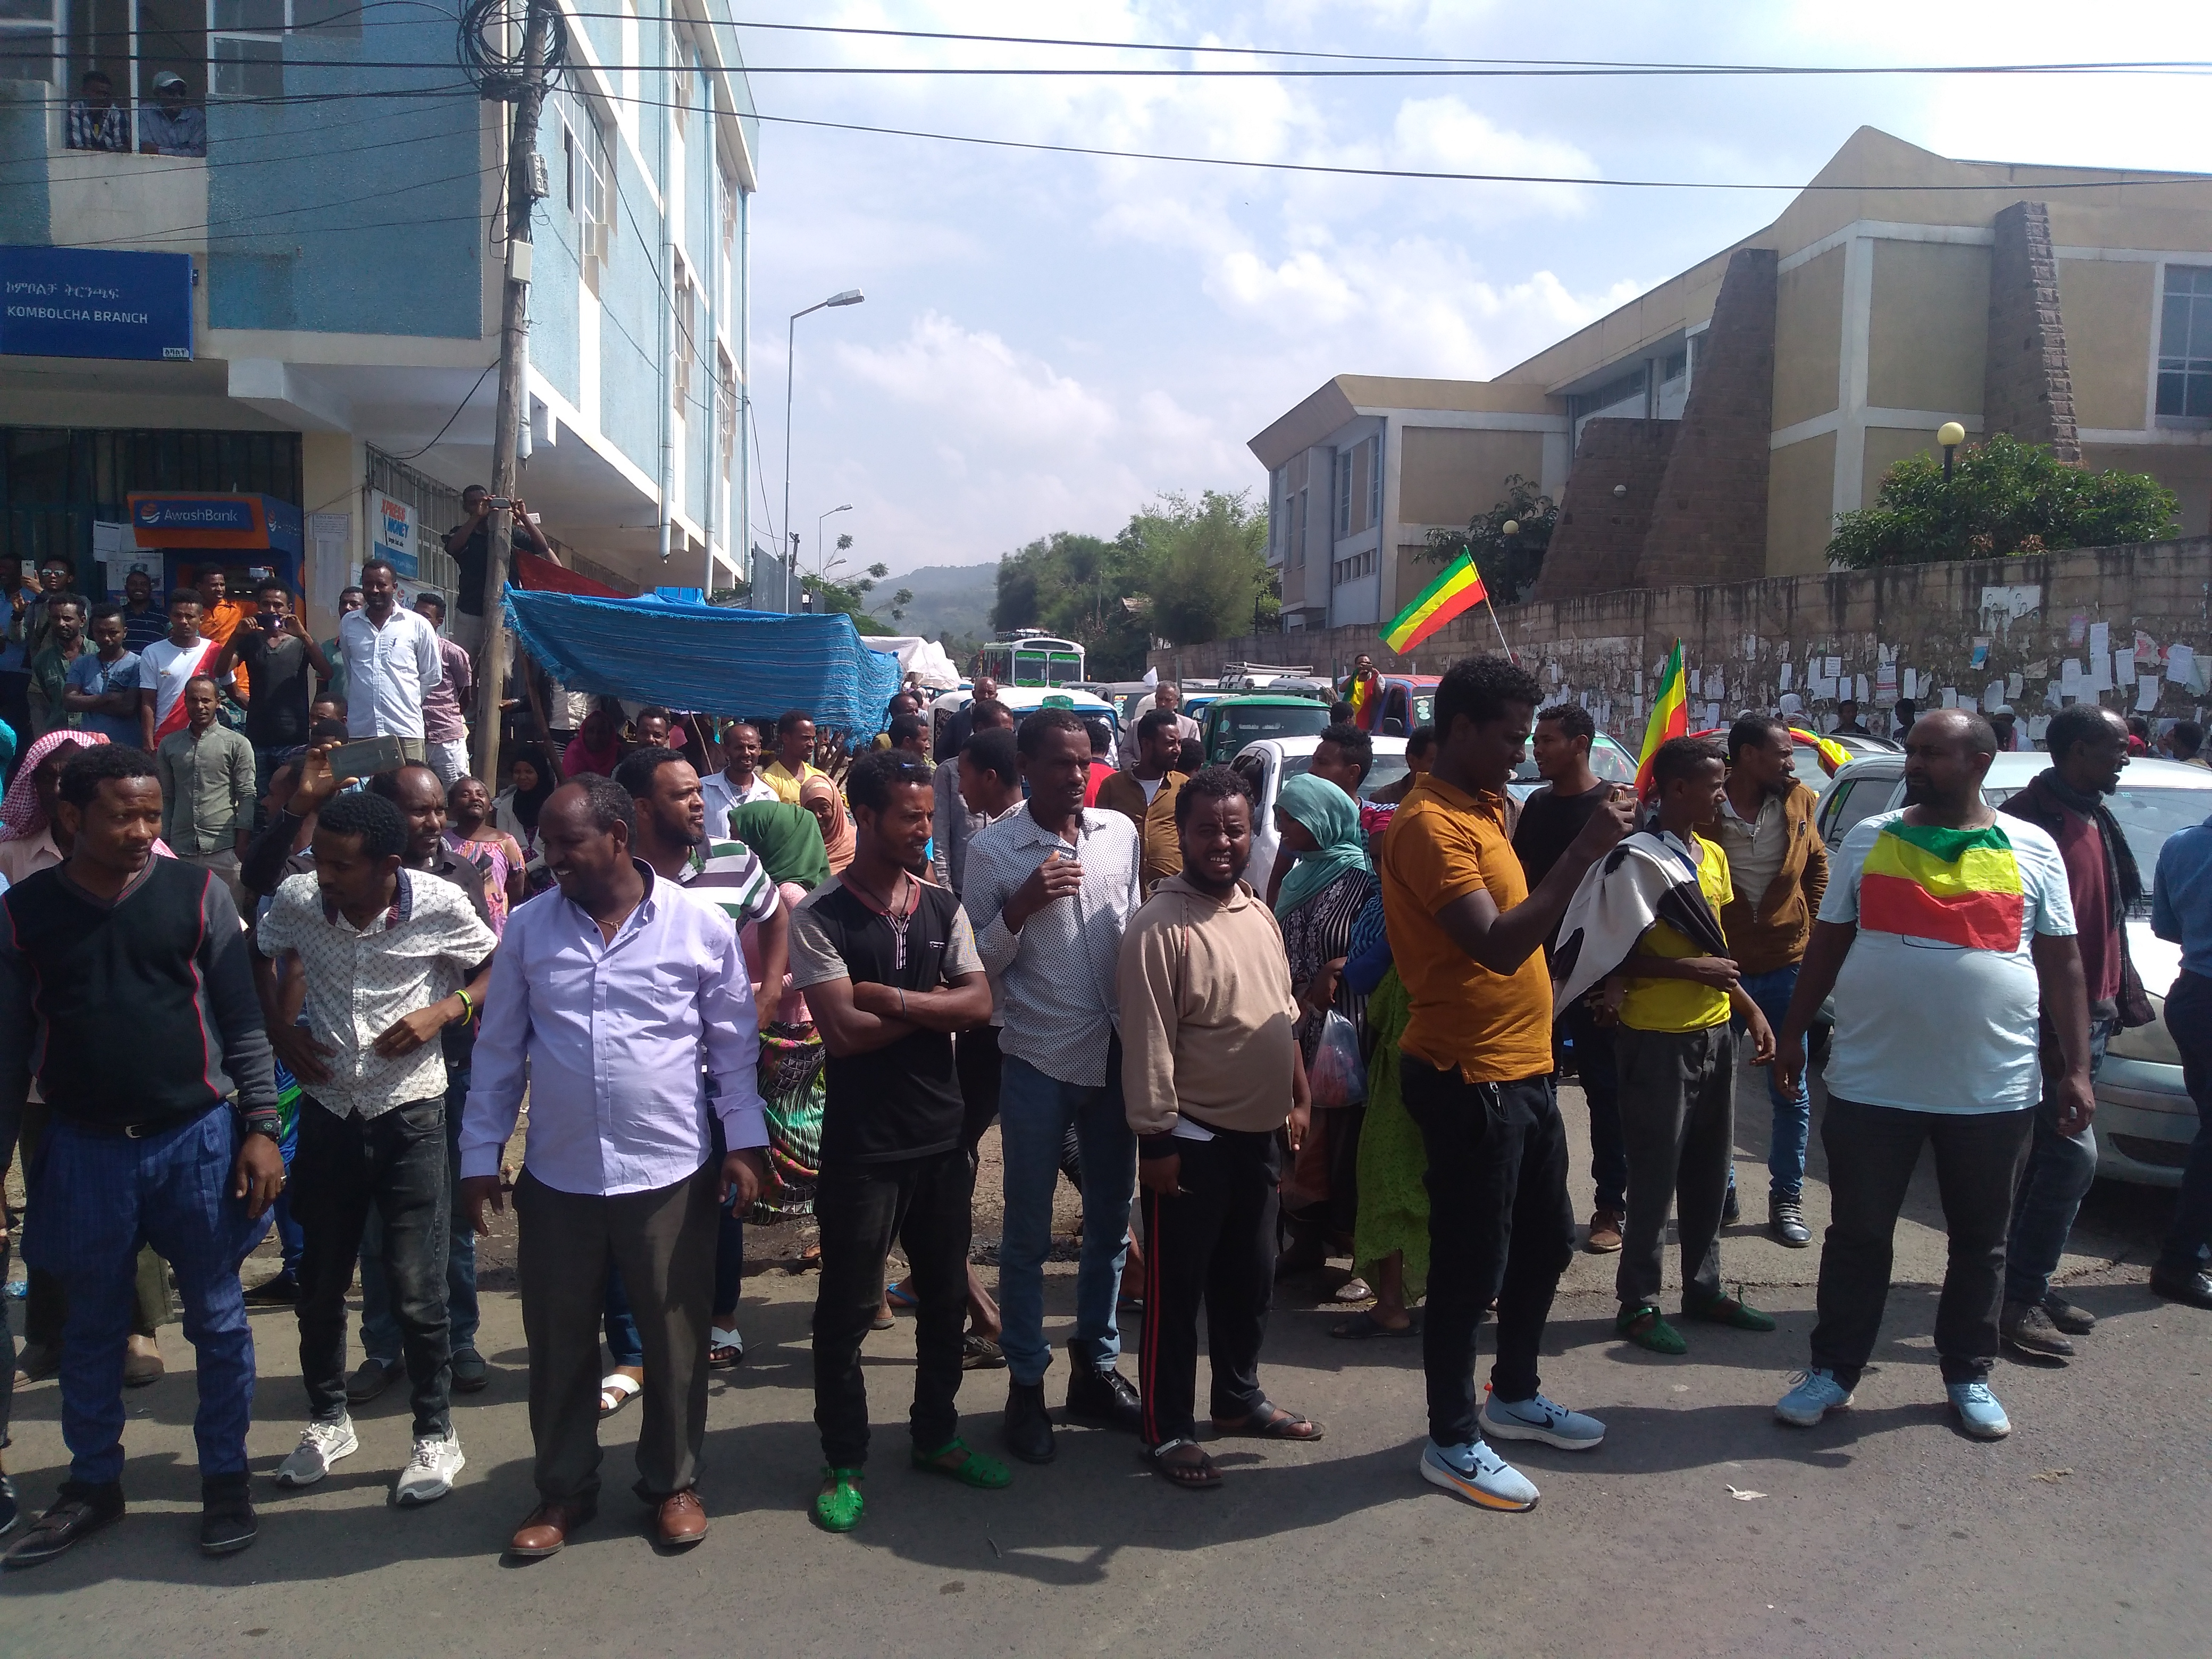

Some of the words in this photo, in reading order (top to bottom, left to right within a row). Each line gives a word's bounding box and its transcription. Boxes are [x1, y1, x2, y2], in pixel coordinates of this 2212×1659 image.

[7, 306, 90, 321] KOMBOLCHA
[94, 311, 148, 324] BRANCH
[164, 509, 238, 521] AwashBank
